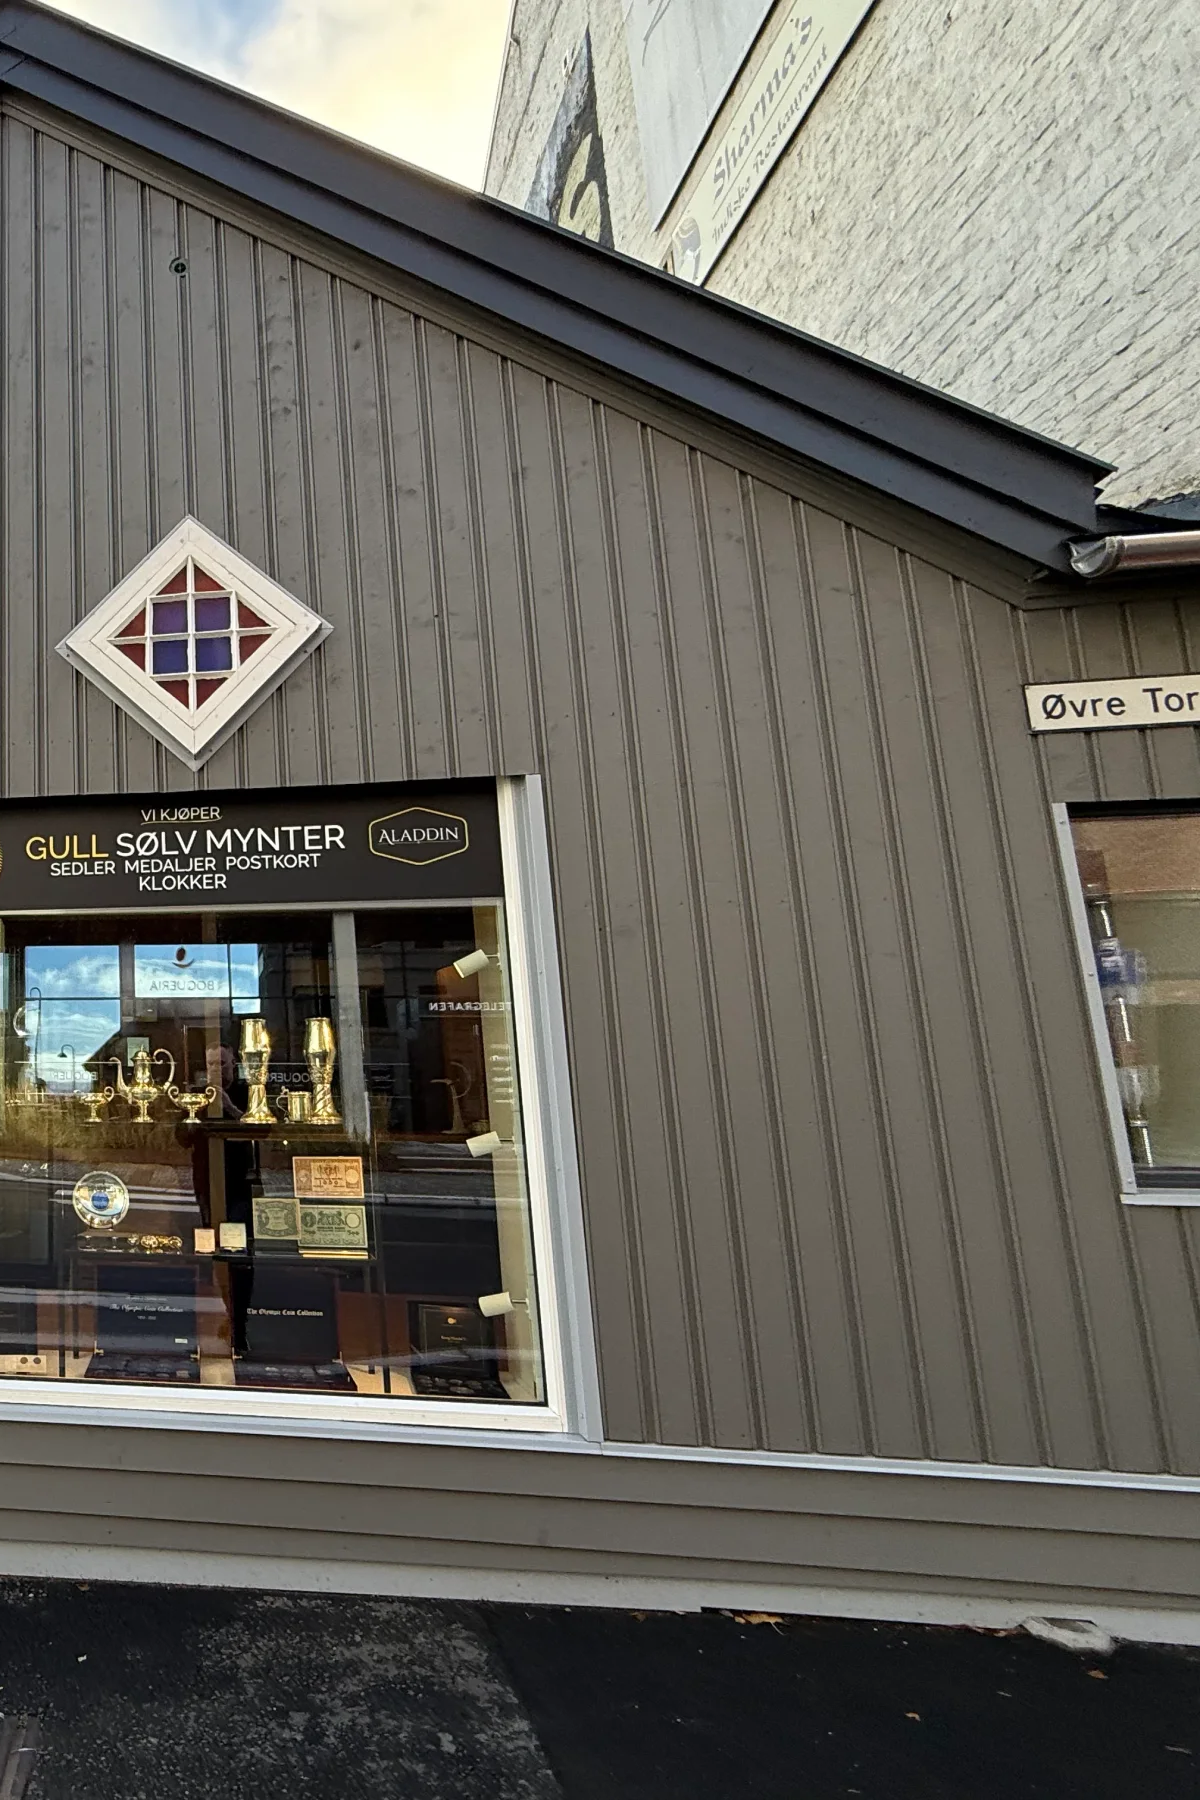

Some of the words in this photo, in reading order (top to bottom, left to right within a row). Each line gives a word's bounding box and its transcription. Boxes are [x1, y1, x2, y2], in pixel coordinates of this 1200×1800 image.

[713, 16, 813, 203] Sharma's
[1041, 693, 1126, 720] Øvre
[140, 809, 156, 822] VI
[160, 806, 221, 821] KJØPER
[25, 834, 109, 860] GULL
[116, 830, 198, 858] SØLV
[207, 824, 346, 853] MYNTER
[378, 827, 459, 846] ALADDIN
[50, 860, 116, 877] SEDLER
[124, 857, 217, 874] MEDALJER
[225, 853, 322, 871] POSTKORT
[139, 874, 228, 892] KLOKKER
